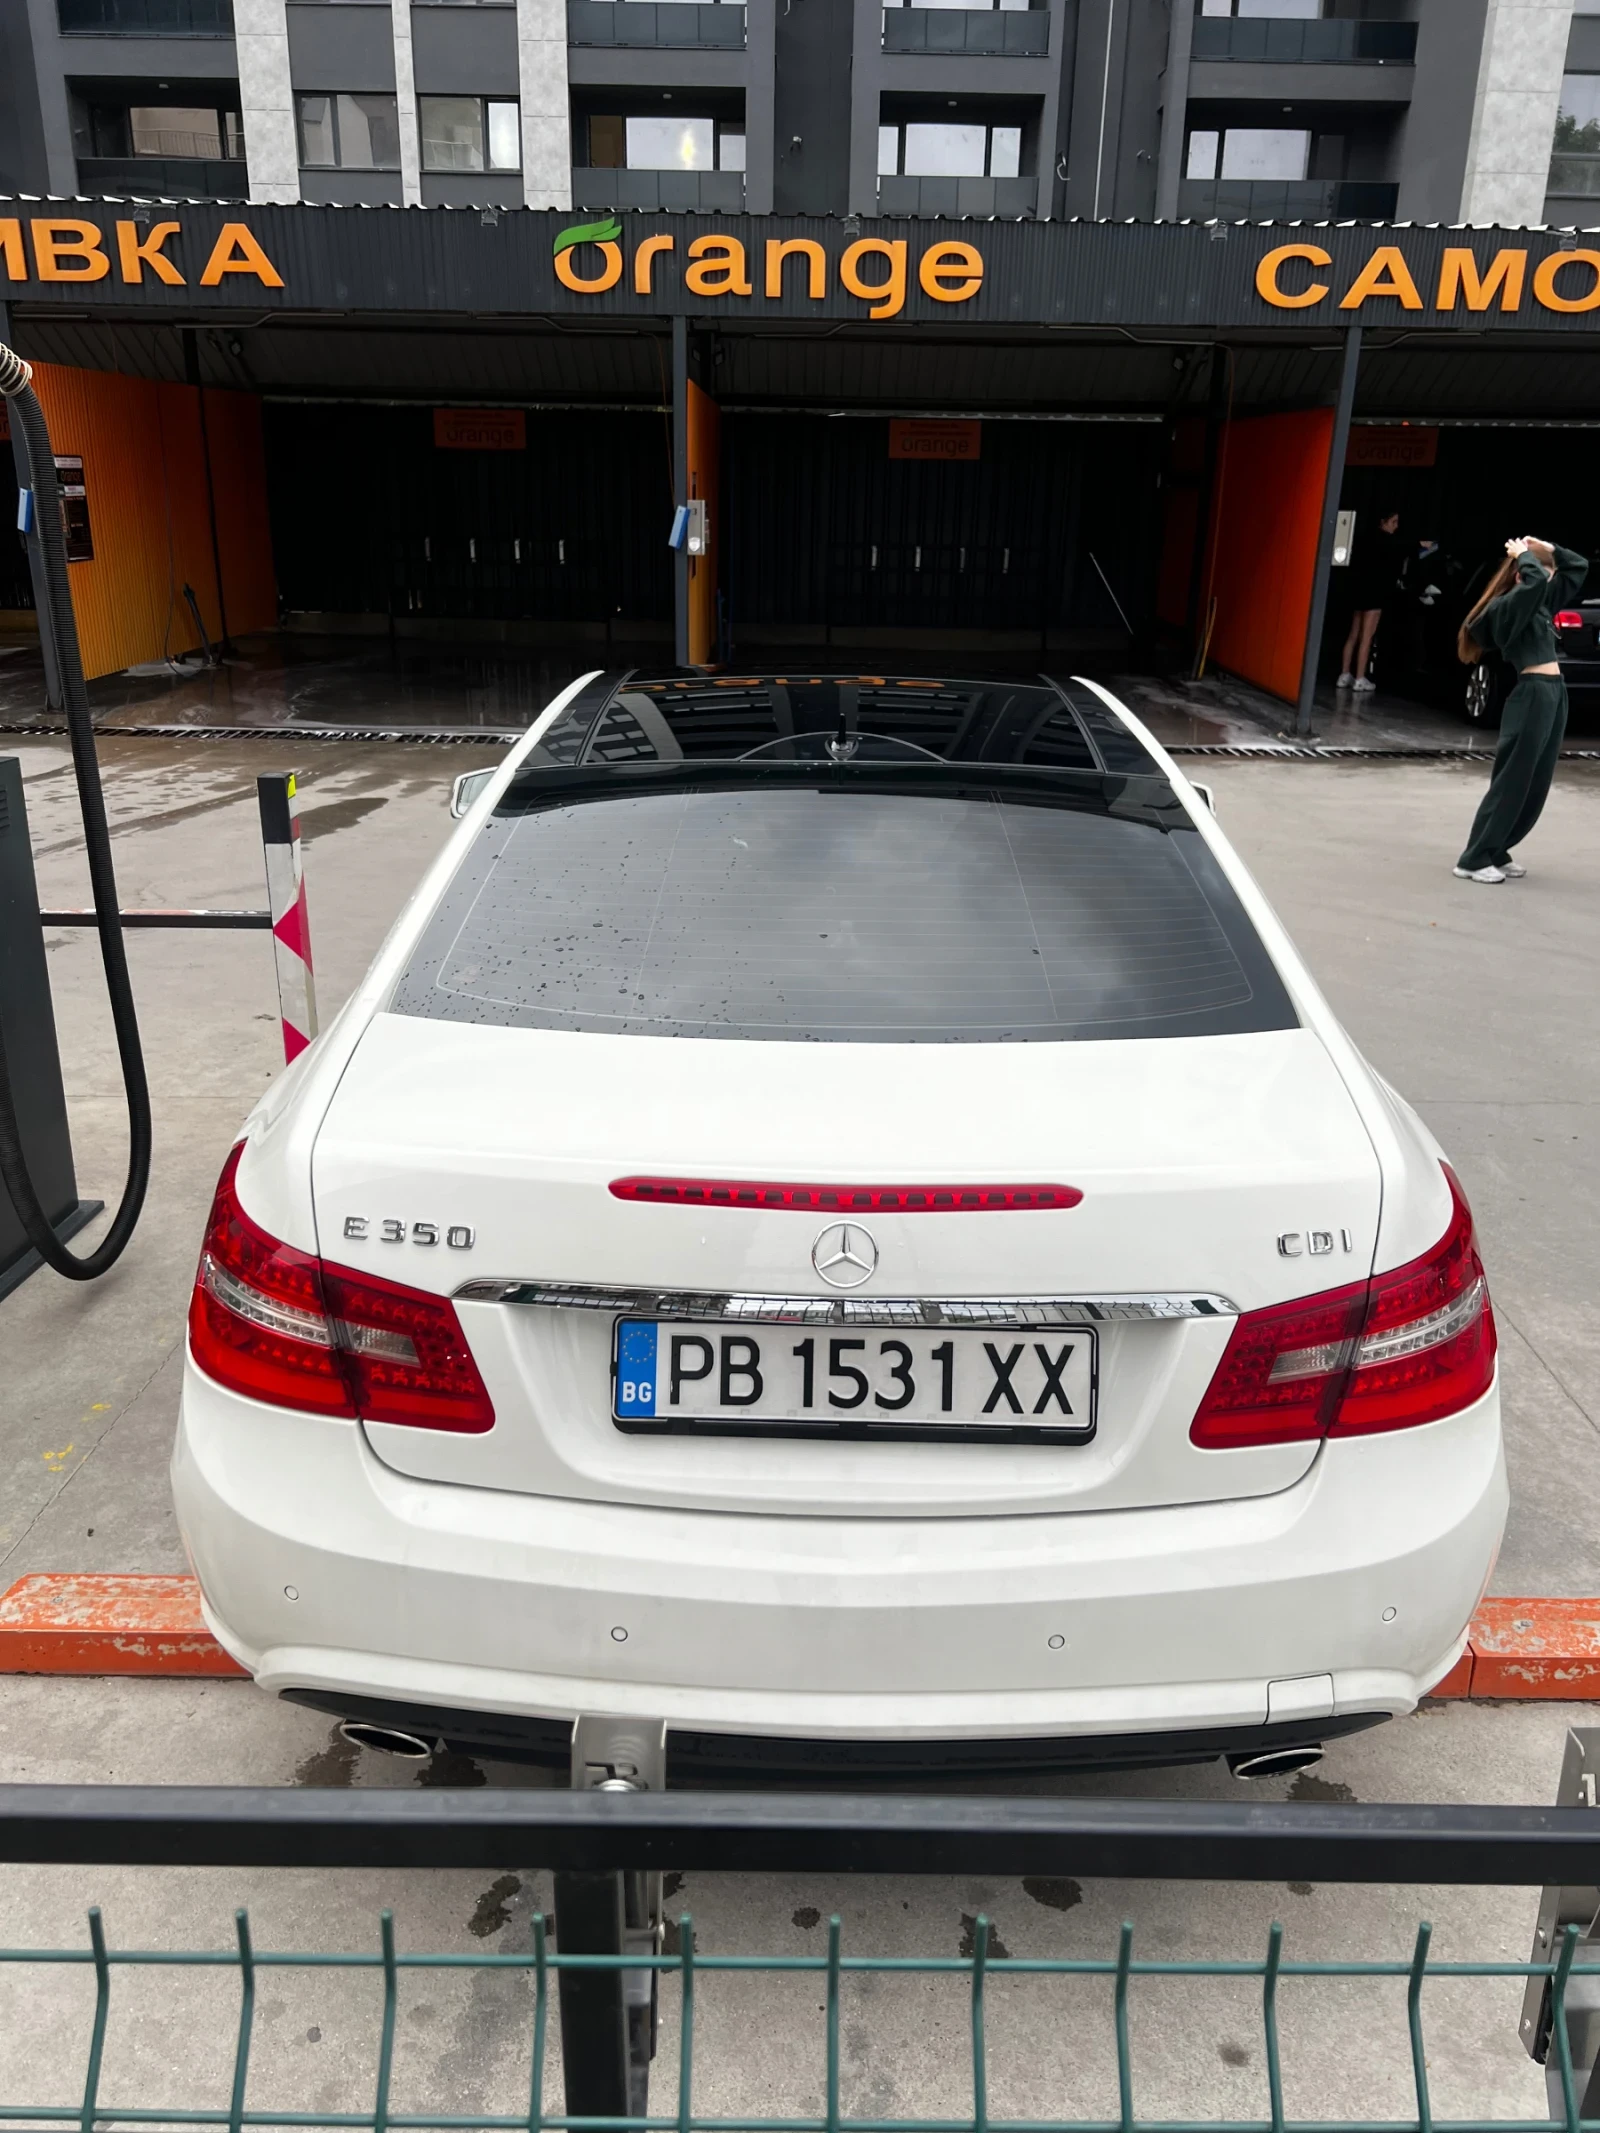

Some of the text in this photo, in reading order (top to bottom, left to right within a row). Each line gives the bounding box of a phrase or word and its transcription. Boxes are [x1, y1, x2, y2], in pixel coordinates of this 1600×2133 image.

[553, 217, 984, 320] orange
[1255, 243, 1600, 313] САМО
[446, 427, 515, 448] orange
[901, 436, 969, 458] orange
[1356, 442, 1427, 465] orange
[343, 1215, 476, 1251] E 350
[1276, 1227, 1353, 1258] CDI
[669, 1334, 1075, 1416] PB 1531 XX
[621, 1380, 653, 1404] BG
